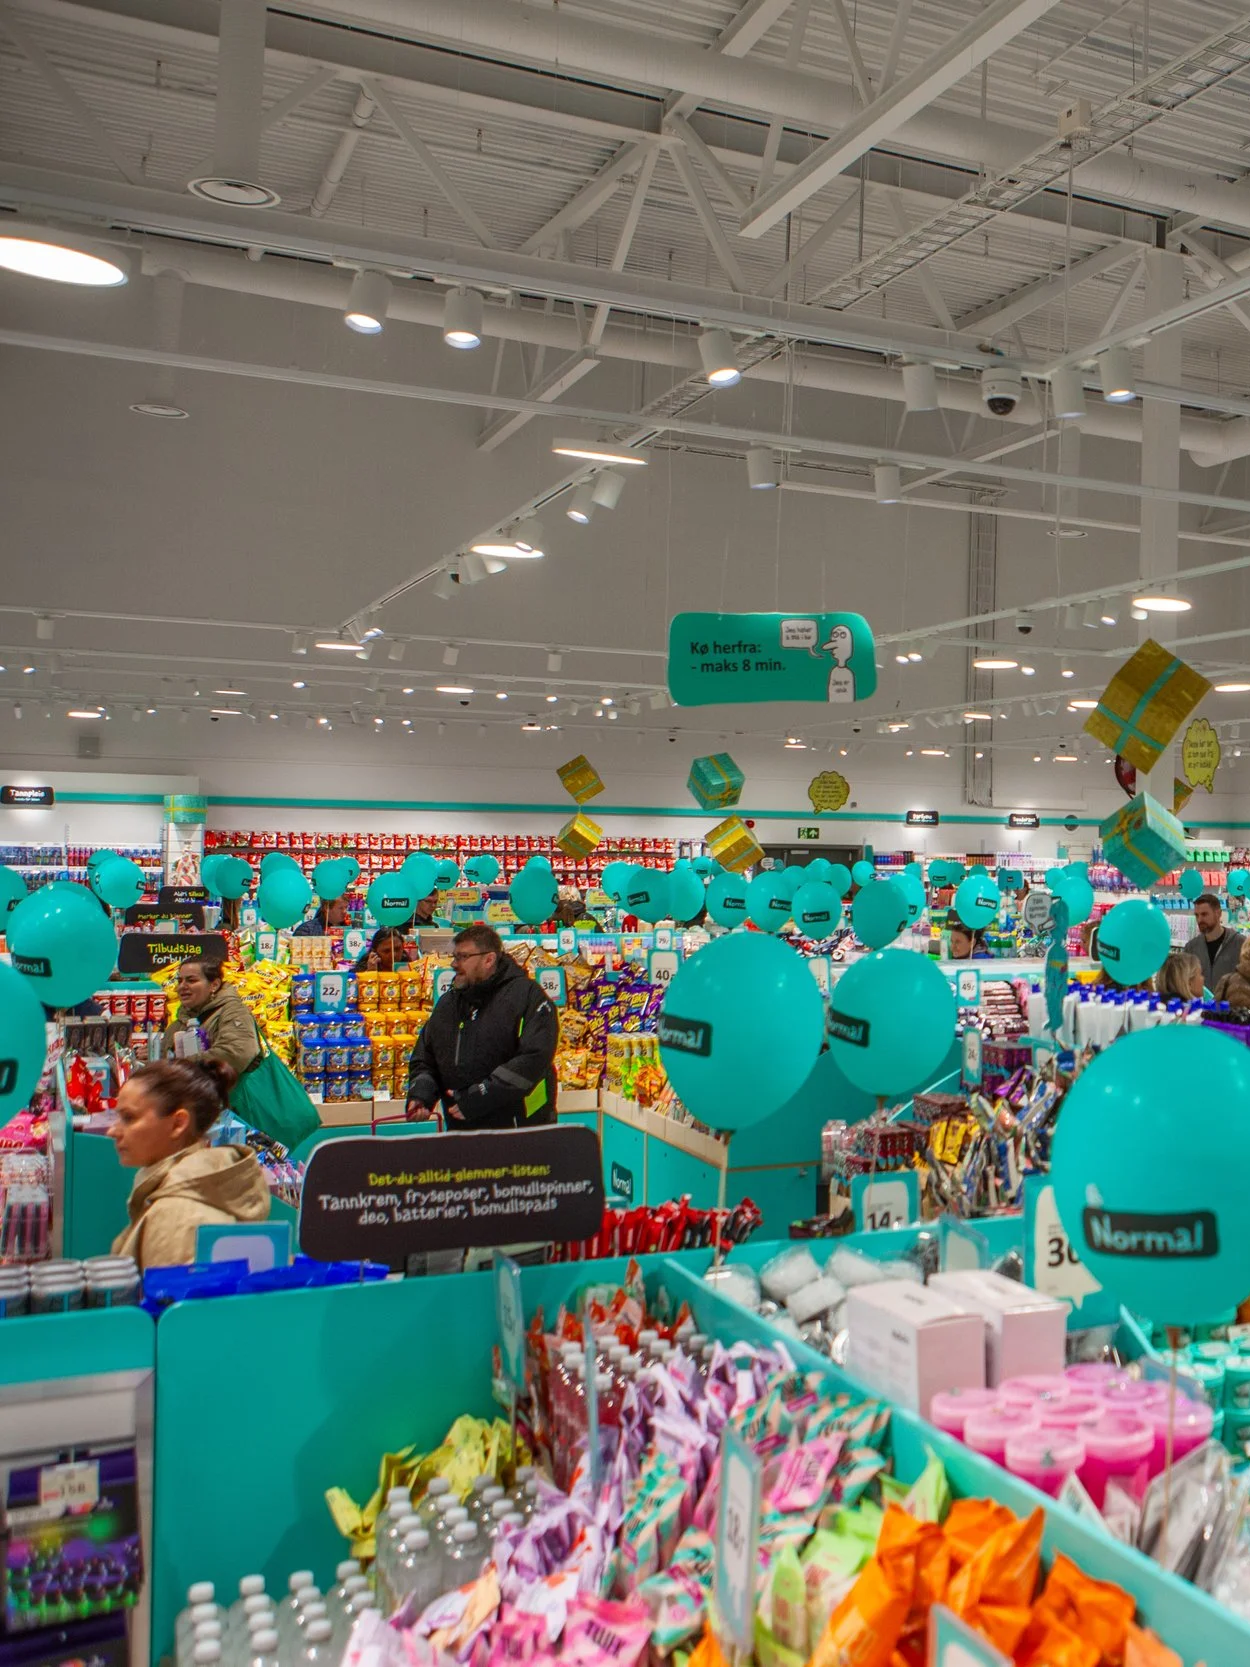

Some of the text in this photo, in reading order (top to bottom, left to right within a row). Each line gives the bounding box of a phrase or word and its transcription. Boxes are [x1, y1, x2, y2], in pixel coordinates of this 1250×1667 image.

[690, 641, 762, 655] Kø herfra:
[701, 660, 738, 673] maks
[742, 660, 751, 671] 8
[755, 659, 786, 672] min.
[384, 899, 408, 907] Normal
[147, 943, 202, 955] Tilbudsjag
[612, 1168, 632, 1196] Normal
[319, 1178, 596, 1211] Tannkrem, fryseposer, bomullspinner,
[359, 1198, 558, 1226] deo, batterier, bomullspads
[868, 1211, 903, 1231] 14-
[1090, 1215, 1204, 1253] Normal
